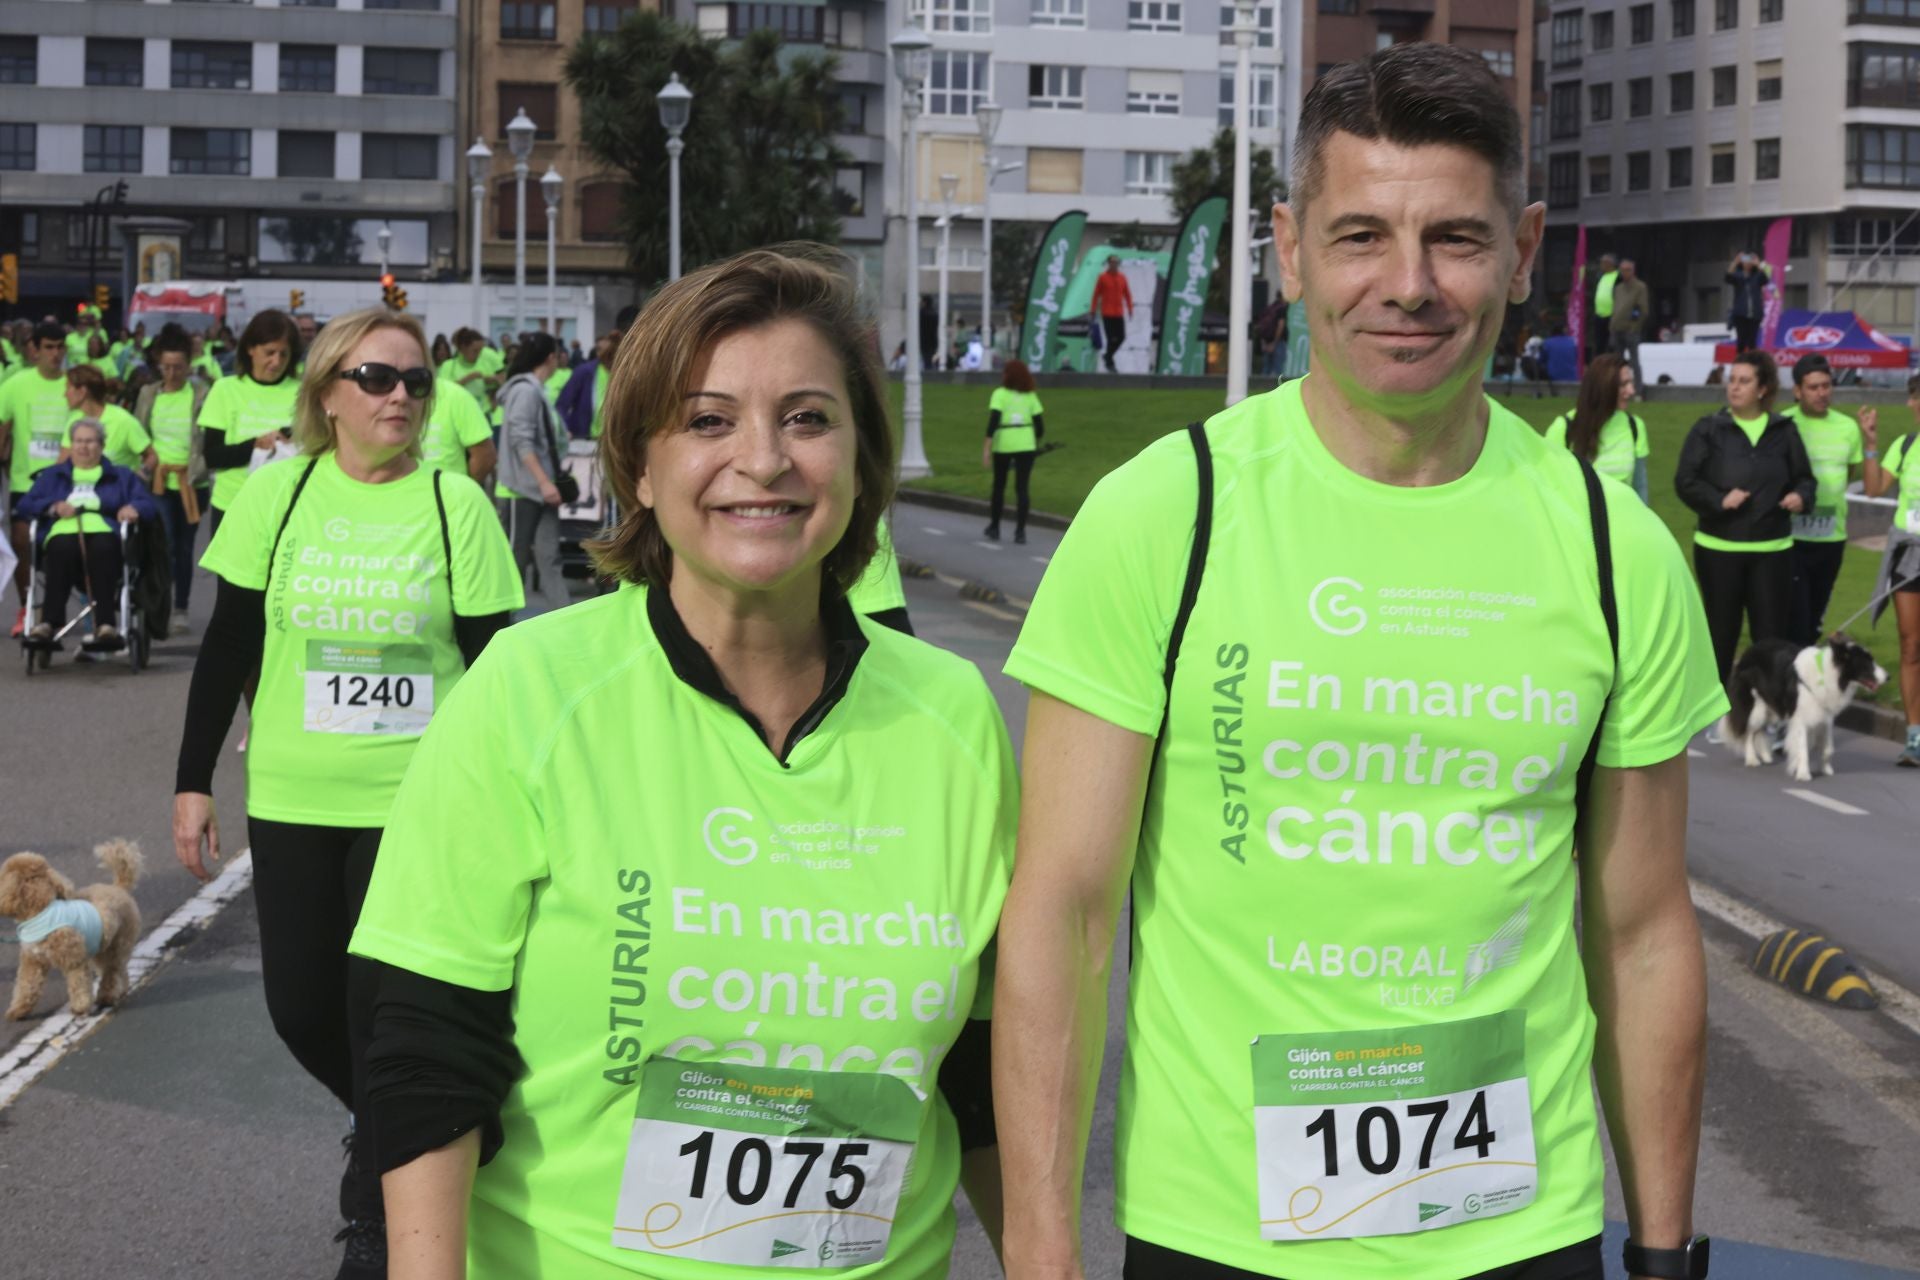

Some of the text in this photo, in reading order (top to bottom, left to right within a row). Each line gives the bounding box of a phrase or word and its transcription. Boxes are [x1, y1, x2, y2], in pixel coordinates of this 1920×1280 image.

[300, 547, 332, 566] En
[293, 574, 399, 600] contra
[1379, 586, 1465, 600] asociación
[291, 598, 433, 636] cáncer
[1379, 603, 1432, 618] contra
[1436, 604, 1450, 617] el
[1379, 622, 1471, 638] en Asturias
[327, 675, 414, 708] 1240
[1267, 660, 1579, 726] En marcha
[1213, 642, 1249, 865] ASTURIAS
[1262, 733, 1568, 795] contra el
[1266, 789, 1544, 866] cáncer
[769, 852, 791, 863] en
[817, 838, 831, 852] el
[672, 887, 965, 948] En marcha
[1267, 935, 1457, 978] LABORAL
[603, 868, 651, 1085] ASTURIAS
[668, 962, 960, 1023] contra el
[1379, 982, 1456, 1007] kutxa
[1287, 1043, 1423, 1065] Gijón en marcha
[680, 1070, 814, 1099] Gijón en marcha
[1289, 1061, 1426, 1080] contra el cáncer
[1299, 1081, 1339, 1092] CARRERA
[1340, 1079, 1376, 1090] CONTRA
[1378, 1078, 1388, 1087] EL
[677, 1087, 811, 1115] contra el cáncer
[683, 1102, 724, 1114] CARRERA
[725, 1107, 760, 1119] CONTRA
[761, 1111, 772, 1120] EL
[1306, 1090, 1496, 1177] 1074
[679, 1131, 870, 1210] 1075
